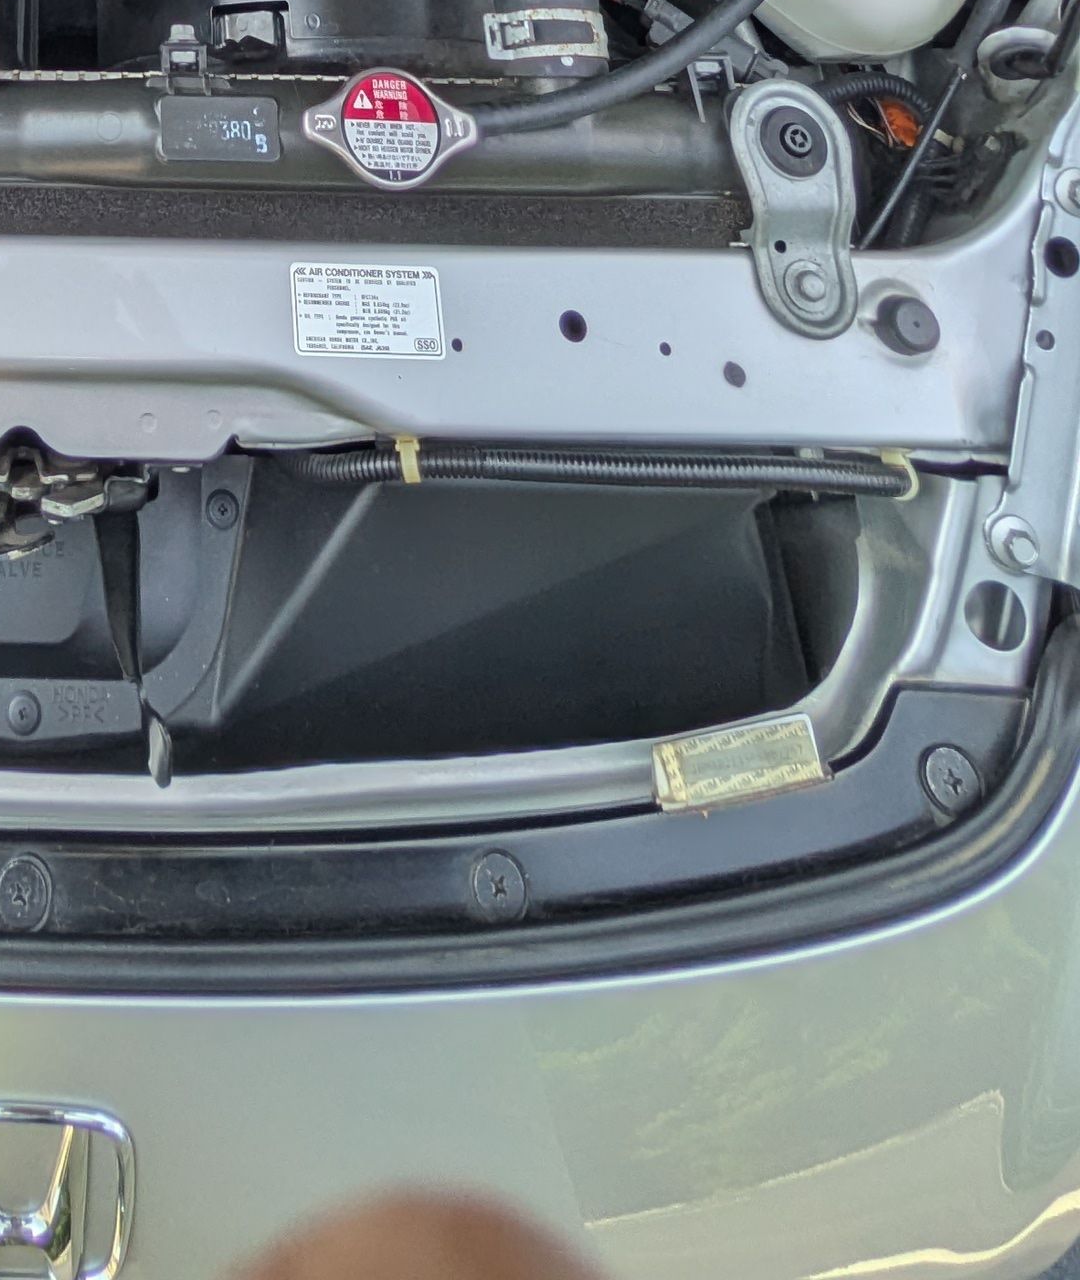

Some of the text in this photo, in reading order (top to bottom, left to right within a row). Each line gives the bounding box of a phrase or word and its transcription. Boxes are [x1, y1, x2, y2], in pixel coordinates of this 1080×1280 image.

[372, 79, 407, 90] DANGER
[309, 268, 420, 279] AIR CONDITIONER SYSTEM
